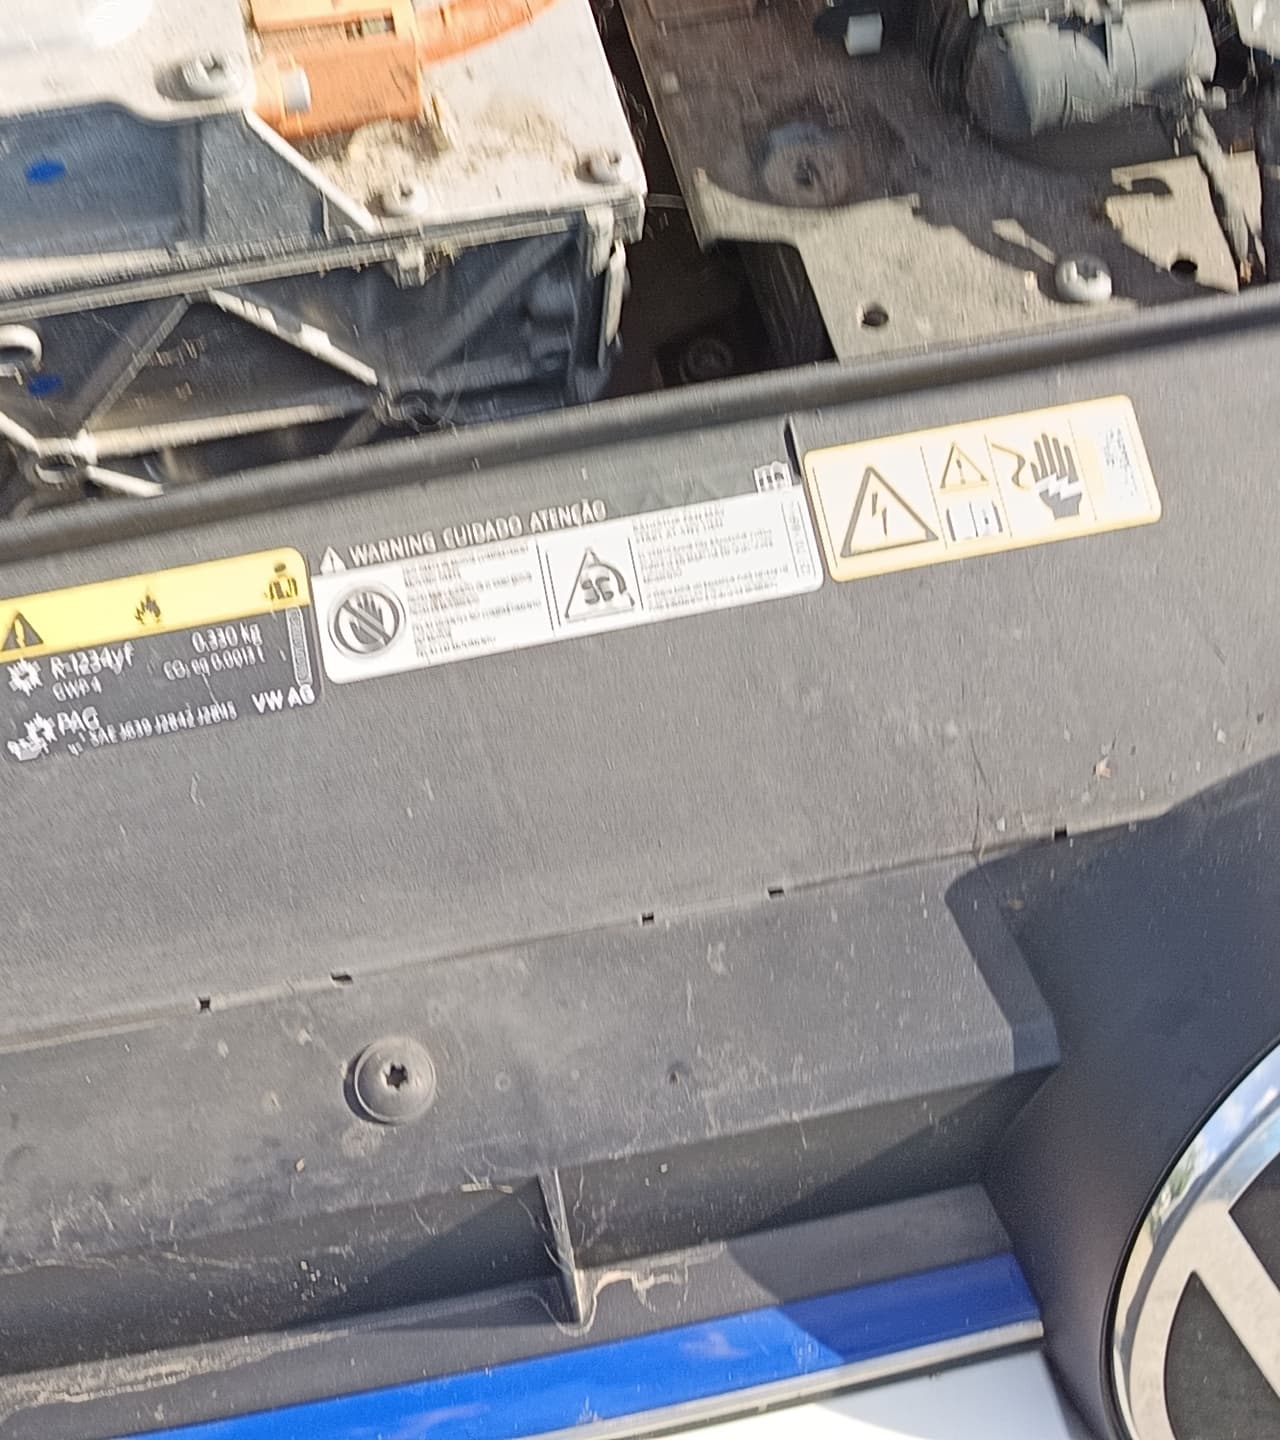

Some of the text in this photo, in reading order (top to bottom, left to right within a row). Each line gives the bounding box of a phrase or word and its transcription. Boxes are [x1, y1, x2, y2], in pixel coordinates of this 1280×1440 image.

[348, 531, 436, 567] WARNING
[442, 515, 523, 549] CUIDADO
[529, 499, 608, 534] ATENÇÃO
[240, 621, 264, 647] kg
[251, 684, 316, 714] VW AG
[57, 706, 99, 736] PAG
